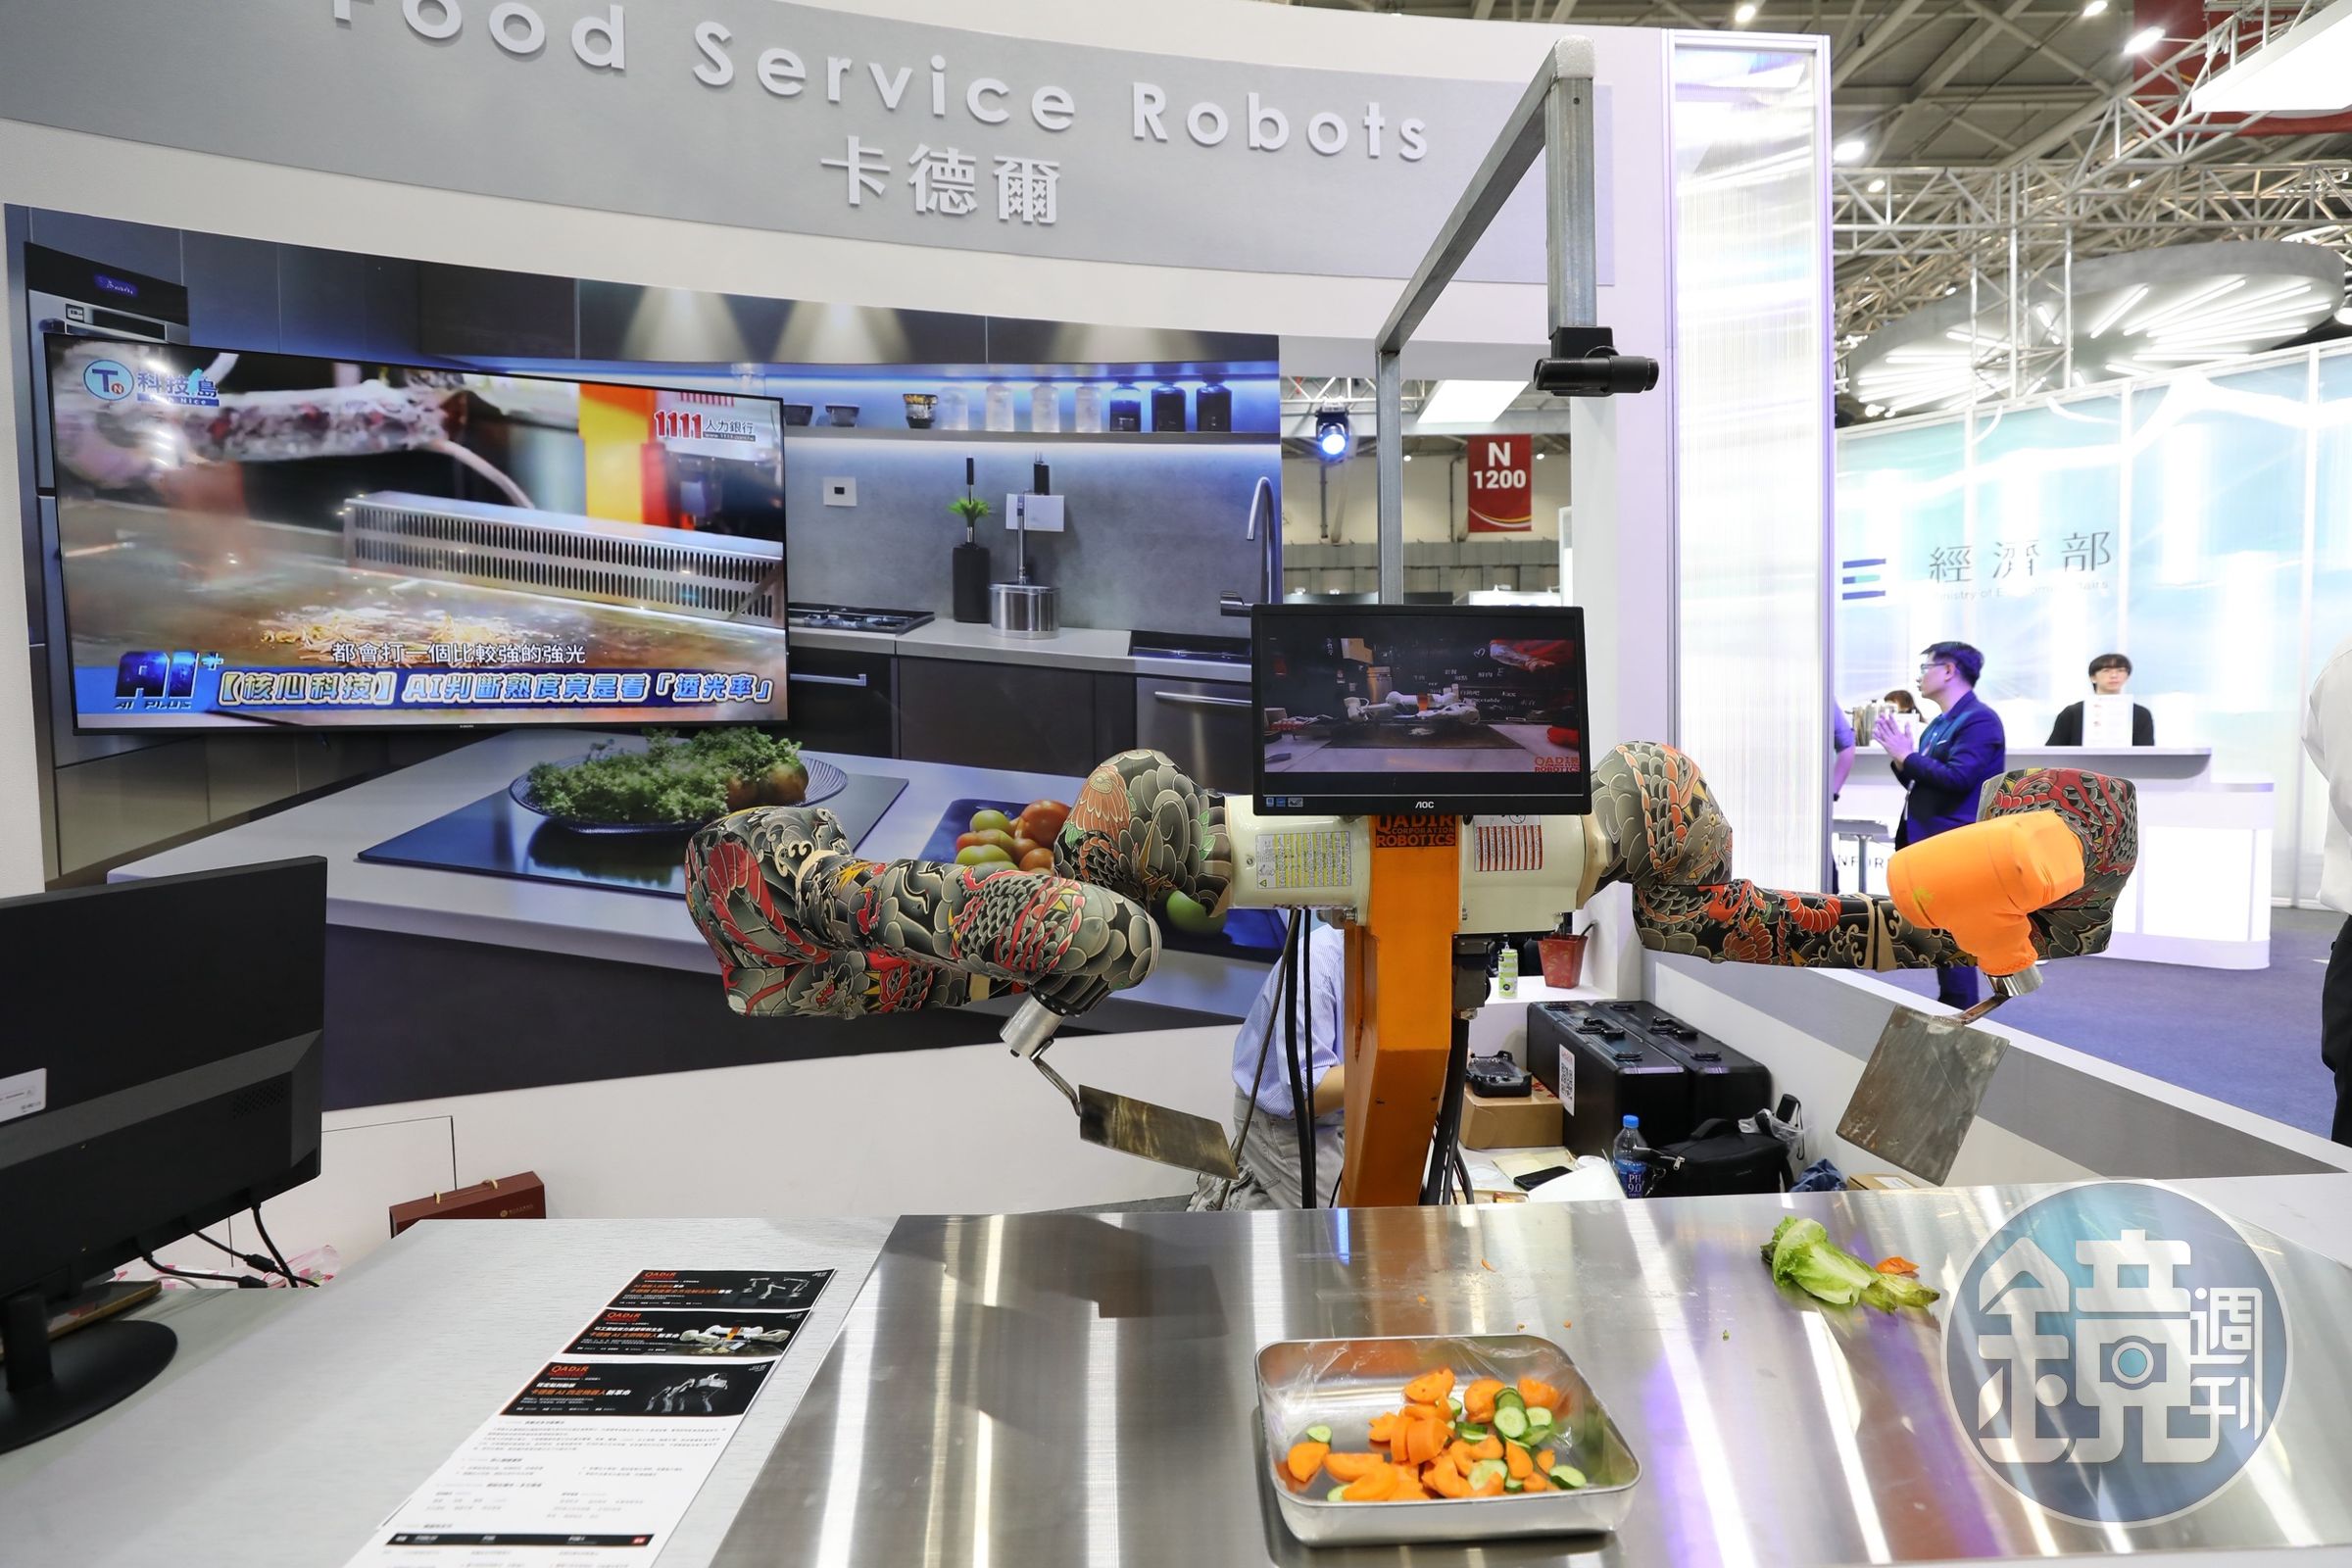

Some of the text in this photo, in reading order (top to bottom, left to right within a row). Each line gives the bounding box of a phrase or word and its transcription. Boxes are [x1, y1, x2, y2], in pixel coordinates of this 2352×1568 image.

[693, 21, 1076, 131] Service
[1132, 81, 1428, 162] Robots
[820, 135, 1061, 224] 卡德爾
[655, 410, 754, 440] 1111 人力銀行
[1488, 442, 1511, 466] N
[1473, 469, 1527, 489] 1200
[1929, 531, 2111, 584] 經濟部
[332, 643, 586, 665] 都會打一個比較強的強光
[1415, 801, 1436, 809] AOC
[1376, 834, 1455, 847] ROBOTICS
[1629, 1174, 1642, 1183] PH
